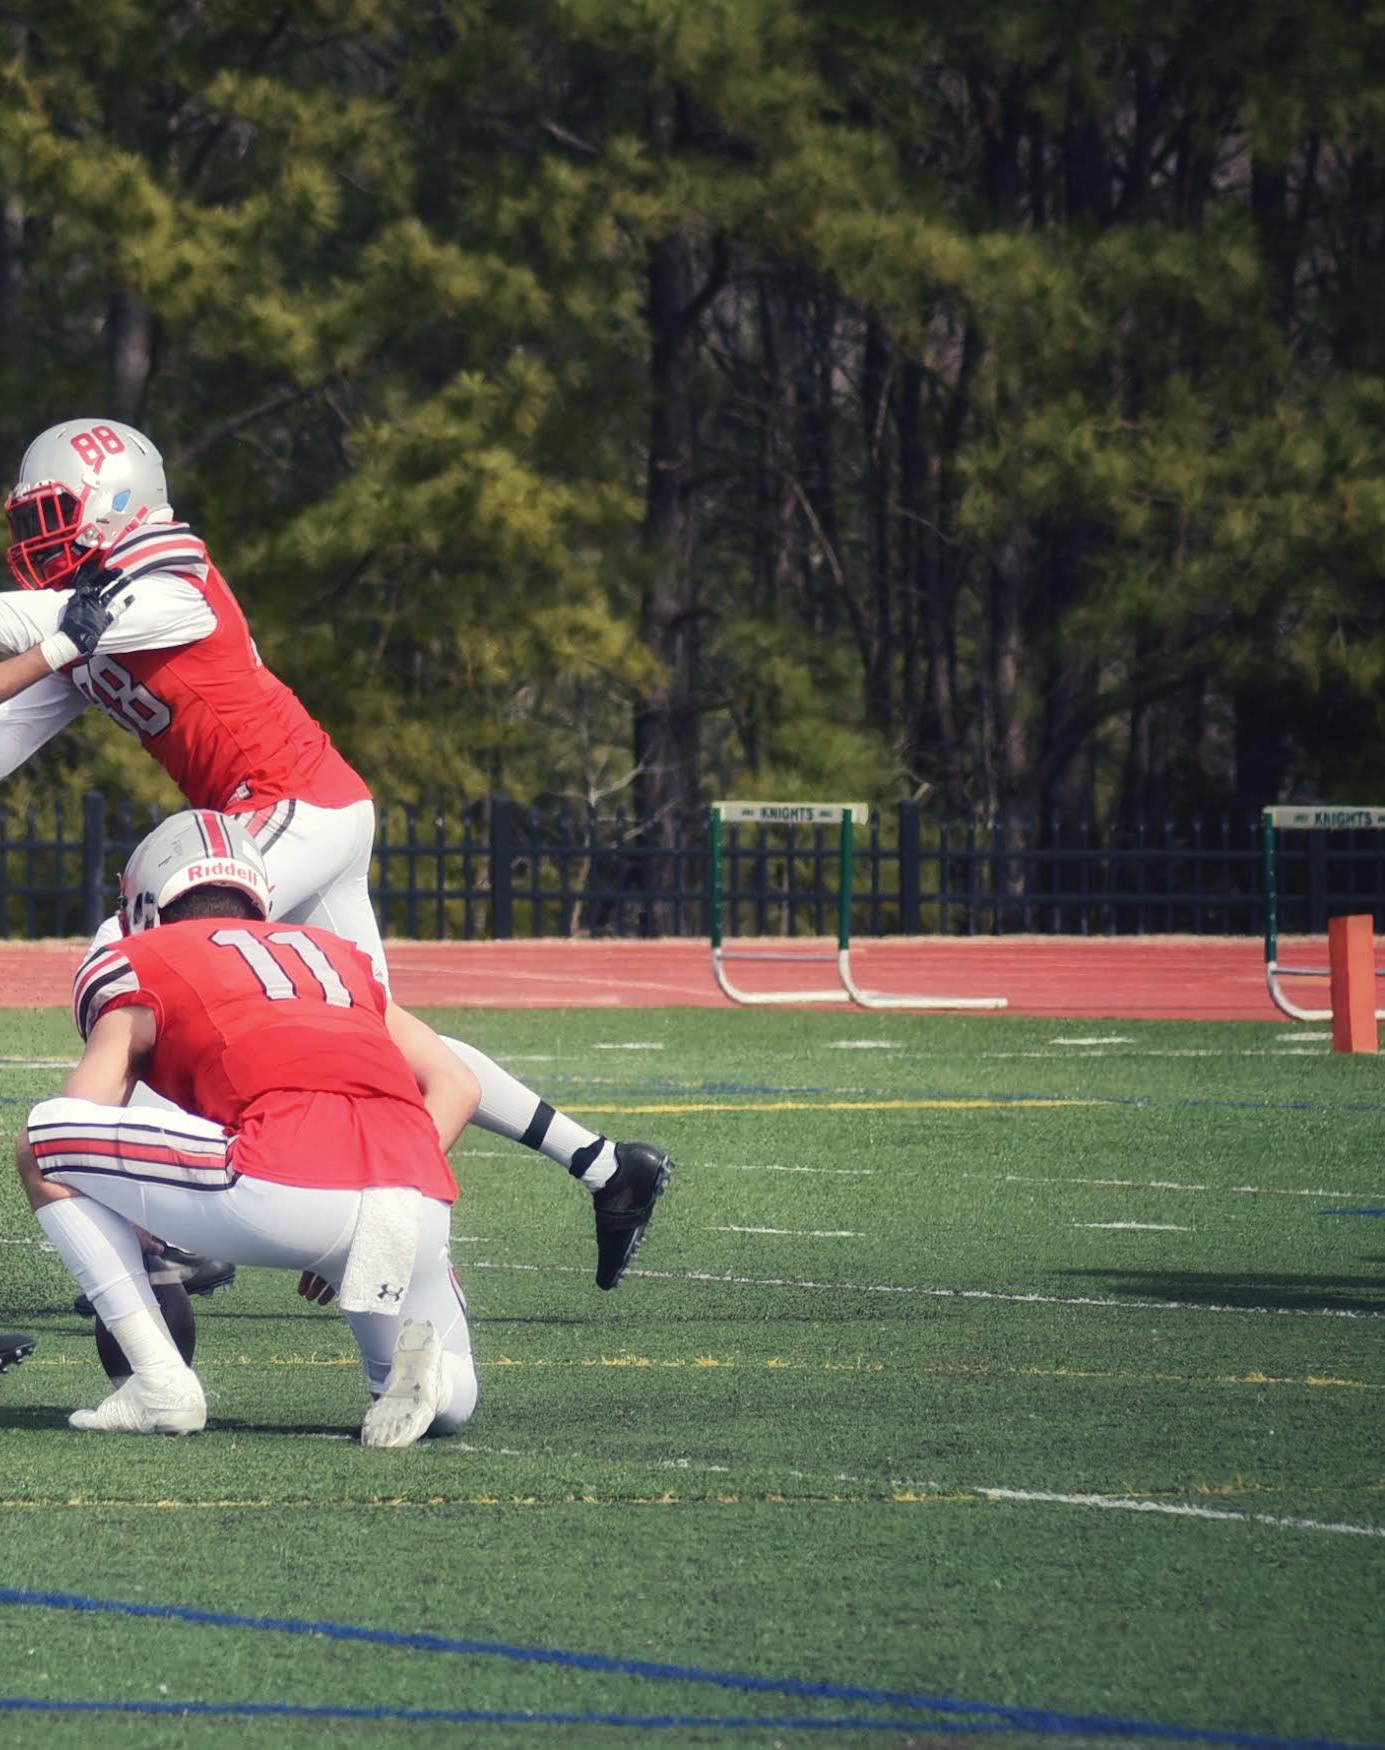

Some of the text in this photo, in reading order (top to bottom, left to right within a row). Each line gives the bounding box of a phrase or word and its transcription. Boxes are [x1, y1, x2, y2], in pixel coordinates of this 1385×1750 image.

[71, 425, 125, 466] 88
[760, 807, 814, 821] KNIGHTS
[1314, 811, 1373, 826] KNIGHTS
[187, 862, 258, 887] Riddell
[209, 929, 354, 1009] 11
